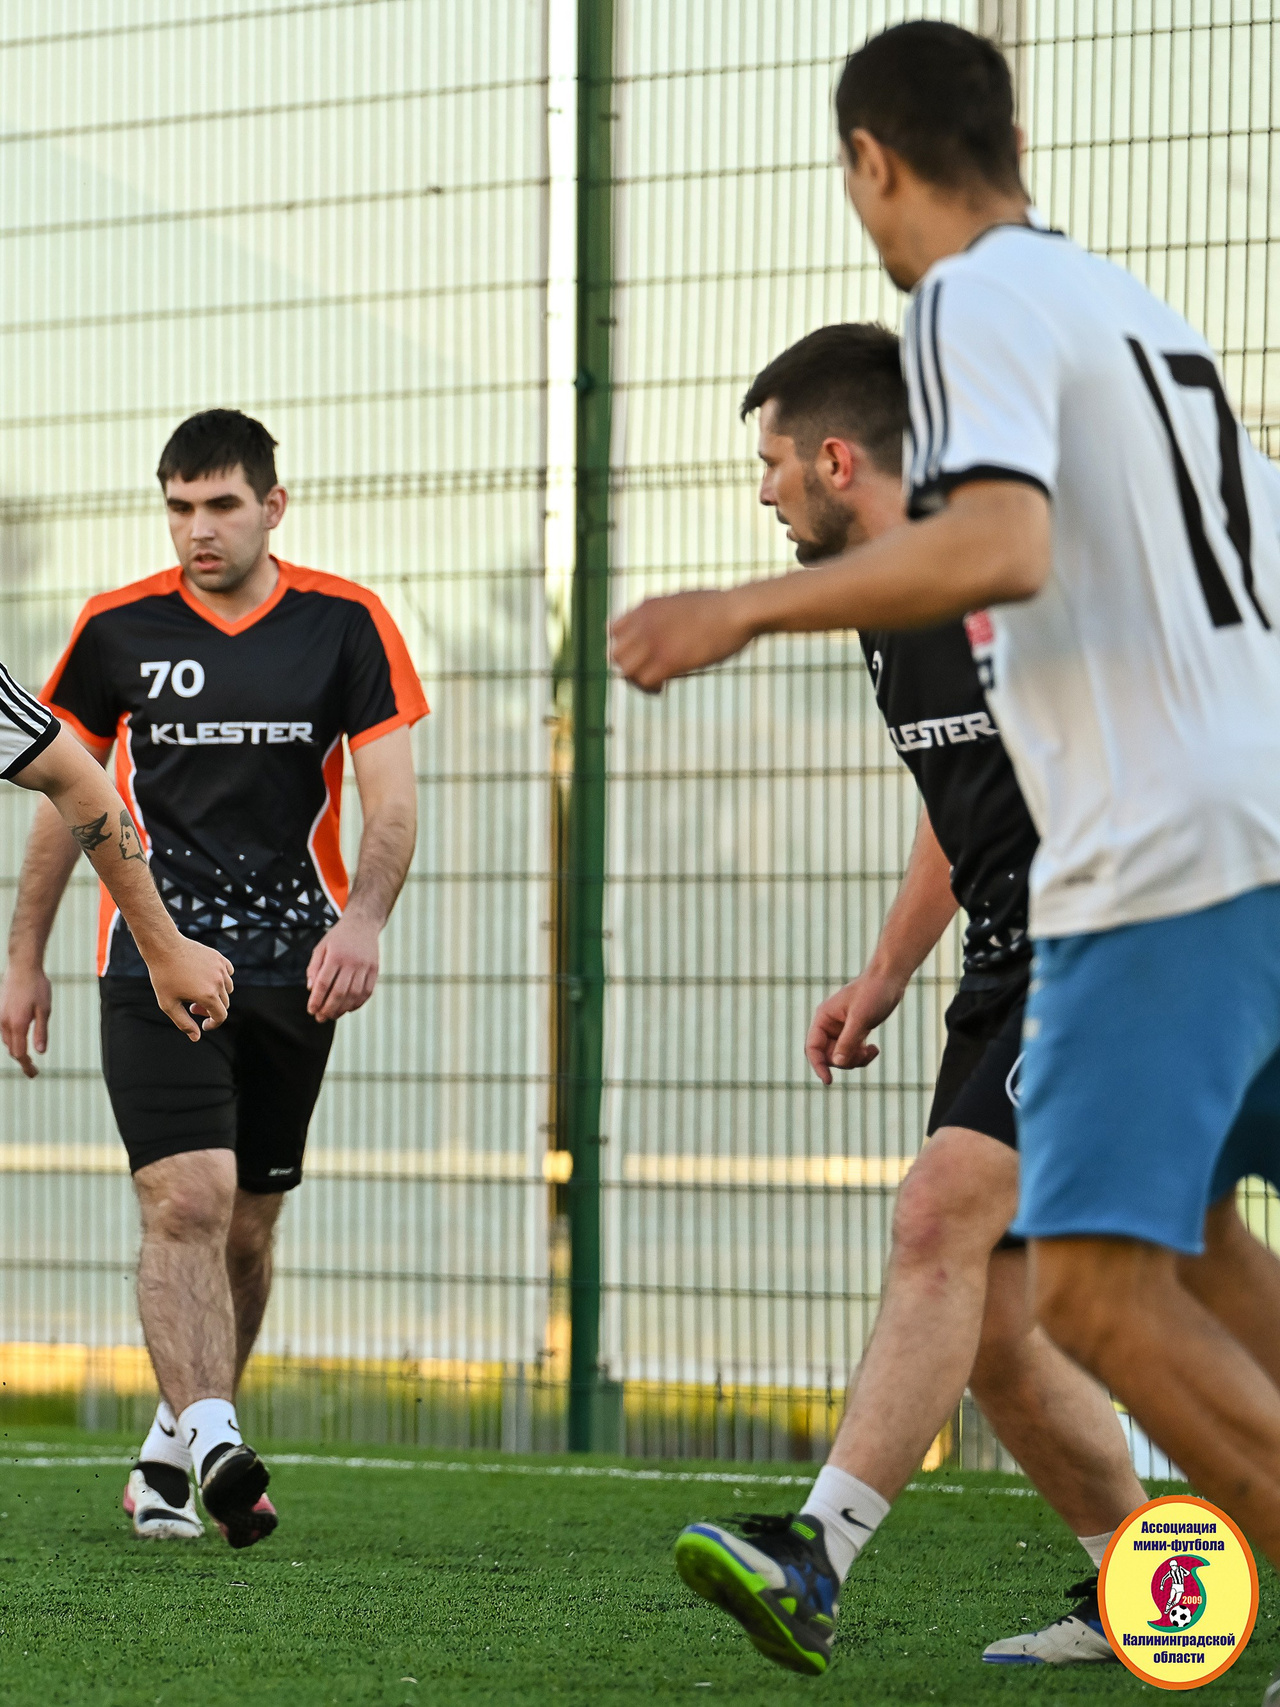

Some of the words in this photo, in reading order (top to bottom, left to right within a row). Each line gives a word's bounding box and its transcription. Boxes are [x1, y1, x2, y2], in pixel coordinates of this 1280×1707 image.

[1124, 335, 1271, 630] 17
[140, 659, 205, 699] 70
[151, 721, 314, 746] KLESTER
[889, 711, 1000, 752] LESTER
